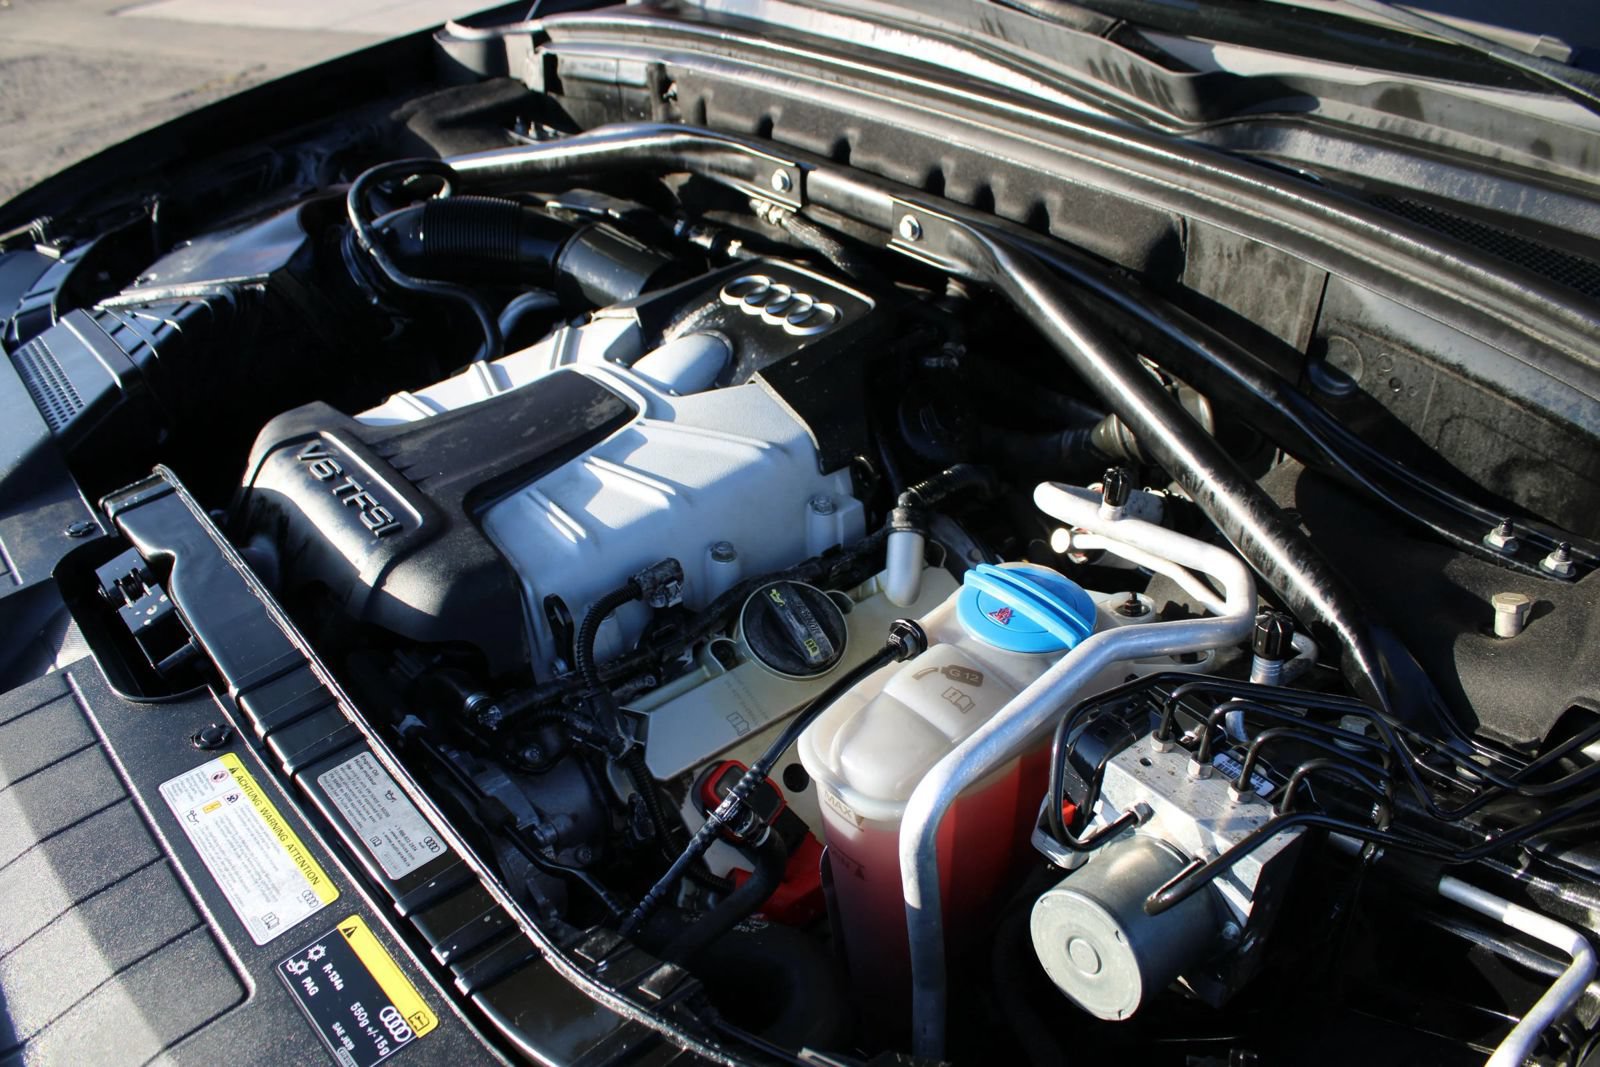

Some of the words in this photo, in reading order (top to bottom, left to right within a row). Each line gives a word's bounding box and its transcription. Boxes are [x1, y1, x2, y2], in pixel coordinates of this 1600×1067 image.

[297, 440, 343, 481] V6
[332, 476, 403, 538] TFSI
[950, 669, 961, 678] G
[965, 671, 979, 682] 12
[234, 773, 263, 807] ACHTUNG
[258, 806, 289, 842] WARNING
[284, 841, 321, 886] ATTENTION
[299, 975, 320, 997] PAG
[320, 962, 347, 991] R-134a
[329, 1020, 346, 1037] SAE
[345, 1000, 373, 1029] 550g
